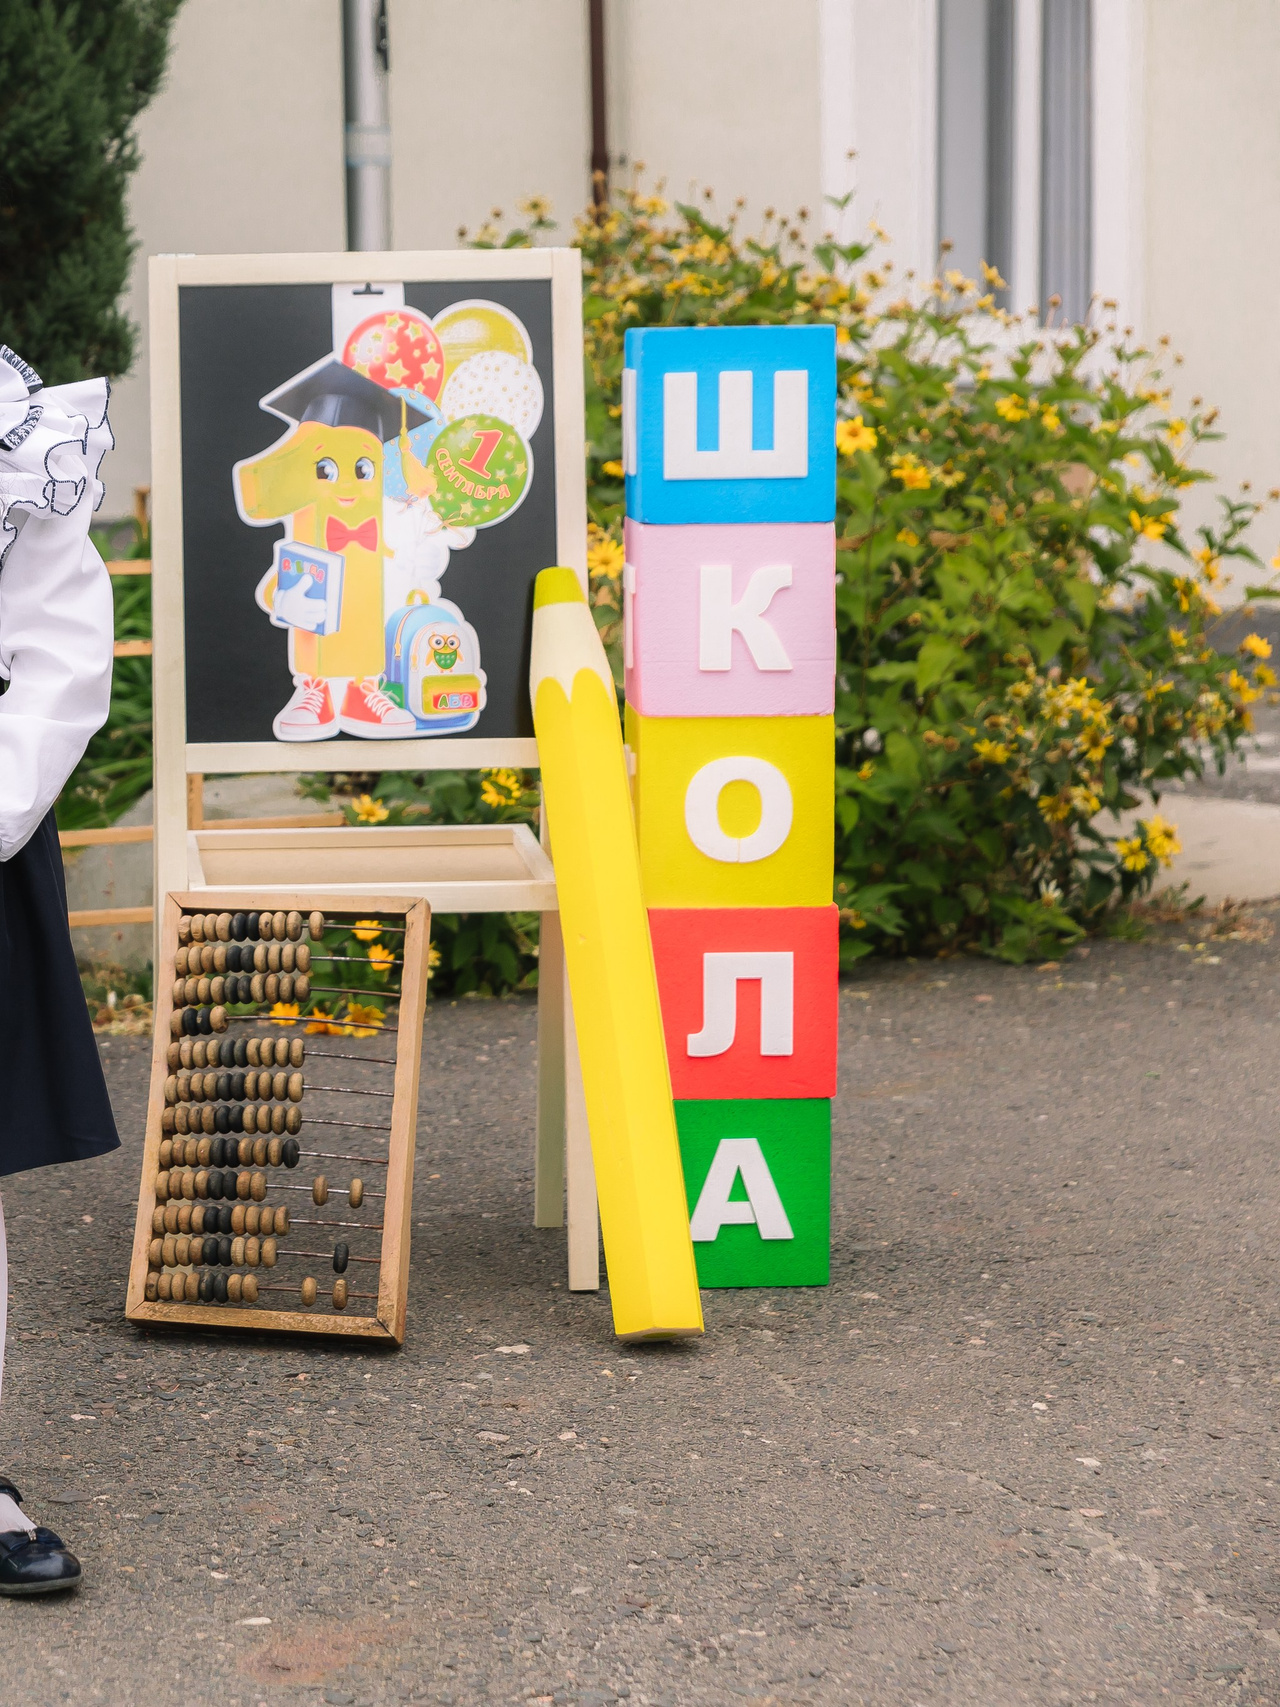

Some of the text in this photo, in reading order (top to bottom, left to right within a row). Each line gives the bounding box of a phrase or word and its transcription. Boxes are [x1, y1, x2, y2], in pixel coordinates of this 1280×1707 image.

[435, 448, 511, 500] СЕНТЯБРЯ
[458, 429, 504, 480] 1
[438, 694, 474, 709] АБВ
[663, 369, 809, 1242] ШКОЛА
